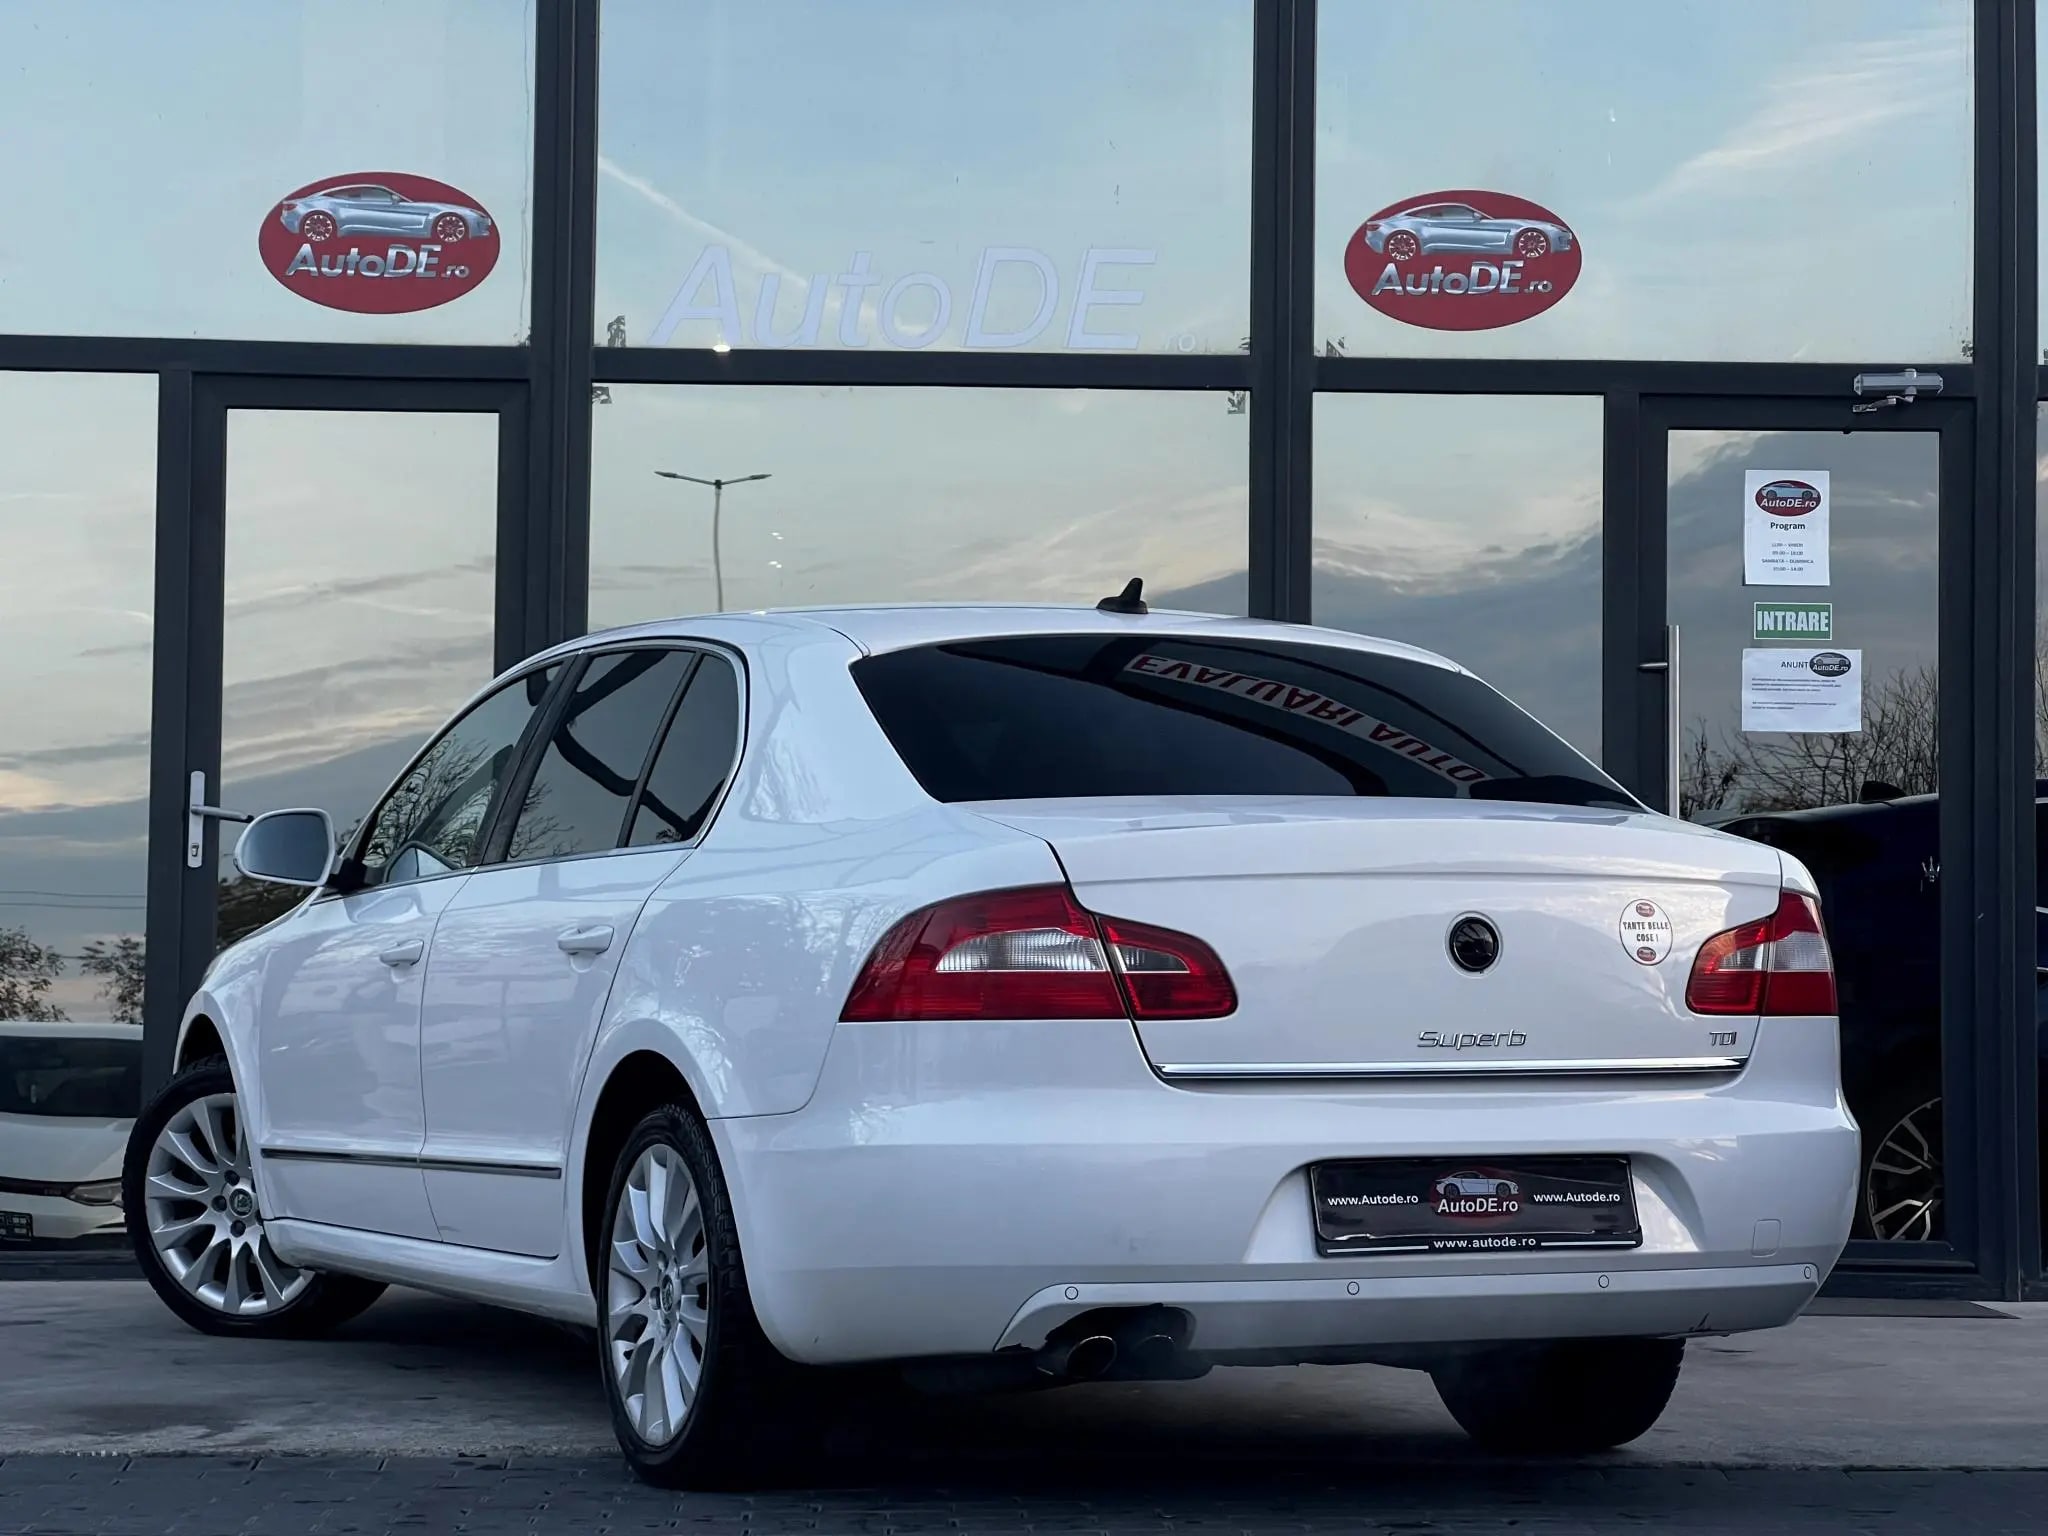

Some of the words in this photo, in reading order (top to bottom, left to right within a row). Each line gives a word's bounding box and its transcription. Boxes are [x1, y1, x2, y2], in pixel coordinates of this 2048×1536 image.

[1760, 498, 1817, 508] AutoDE.ro
[1770, 522, 1806, 531] Program
[1757, 610, 1829, 632] INTRARE
[1623, 921, 1646, 930] TANTE
[1647, 921, 1670, 930] BELLE
[1417, 1029, 1527, 1050] Superb
[1709, 1031, 1737, 1046] TDI
[1327, 1193, 1419, 1206] www.Autode.ro
[1533, 1191, 1621, 1203] www.Autode.ro
[1437, 1197, 1519, 1213] AutoDE.ro
[1434, 1236, 1537, 1249] www.autode.ro
